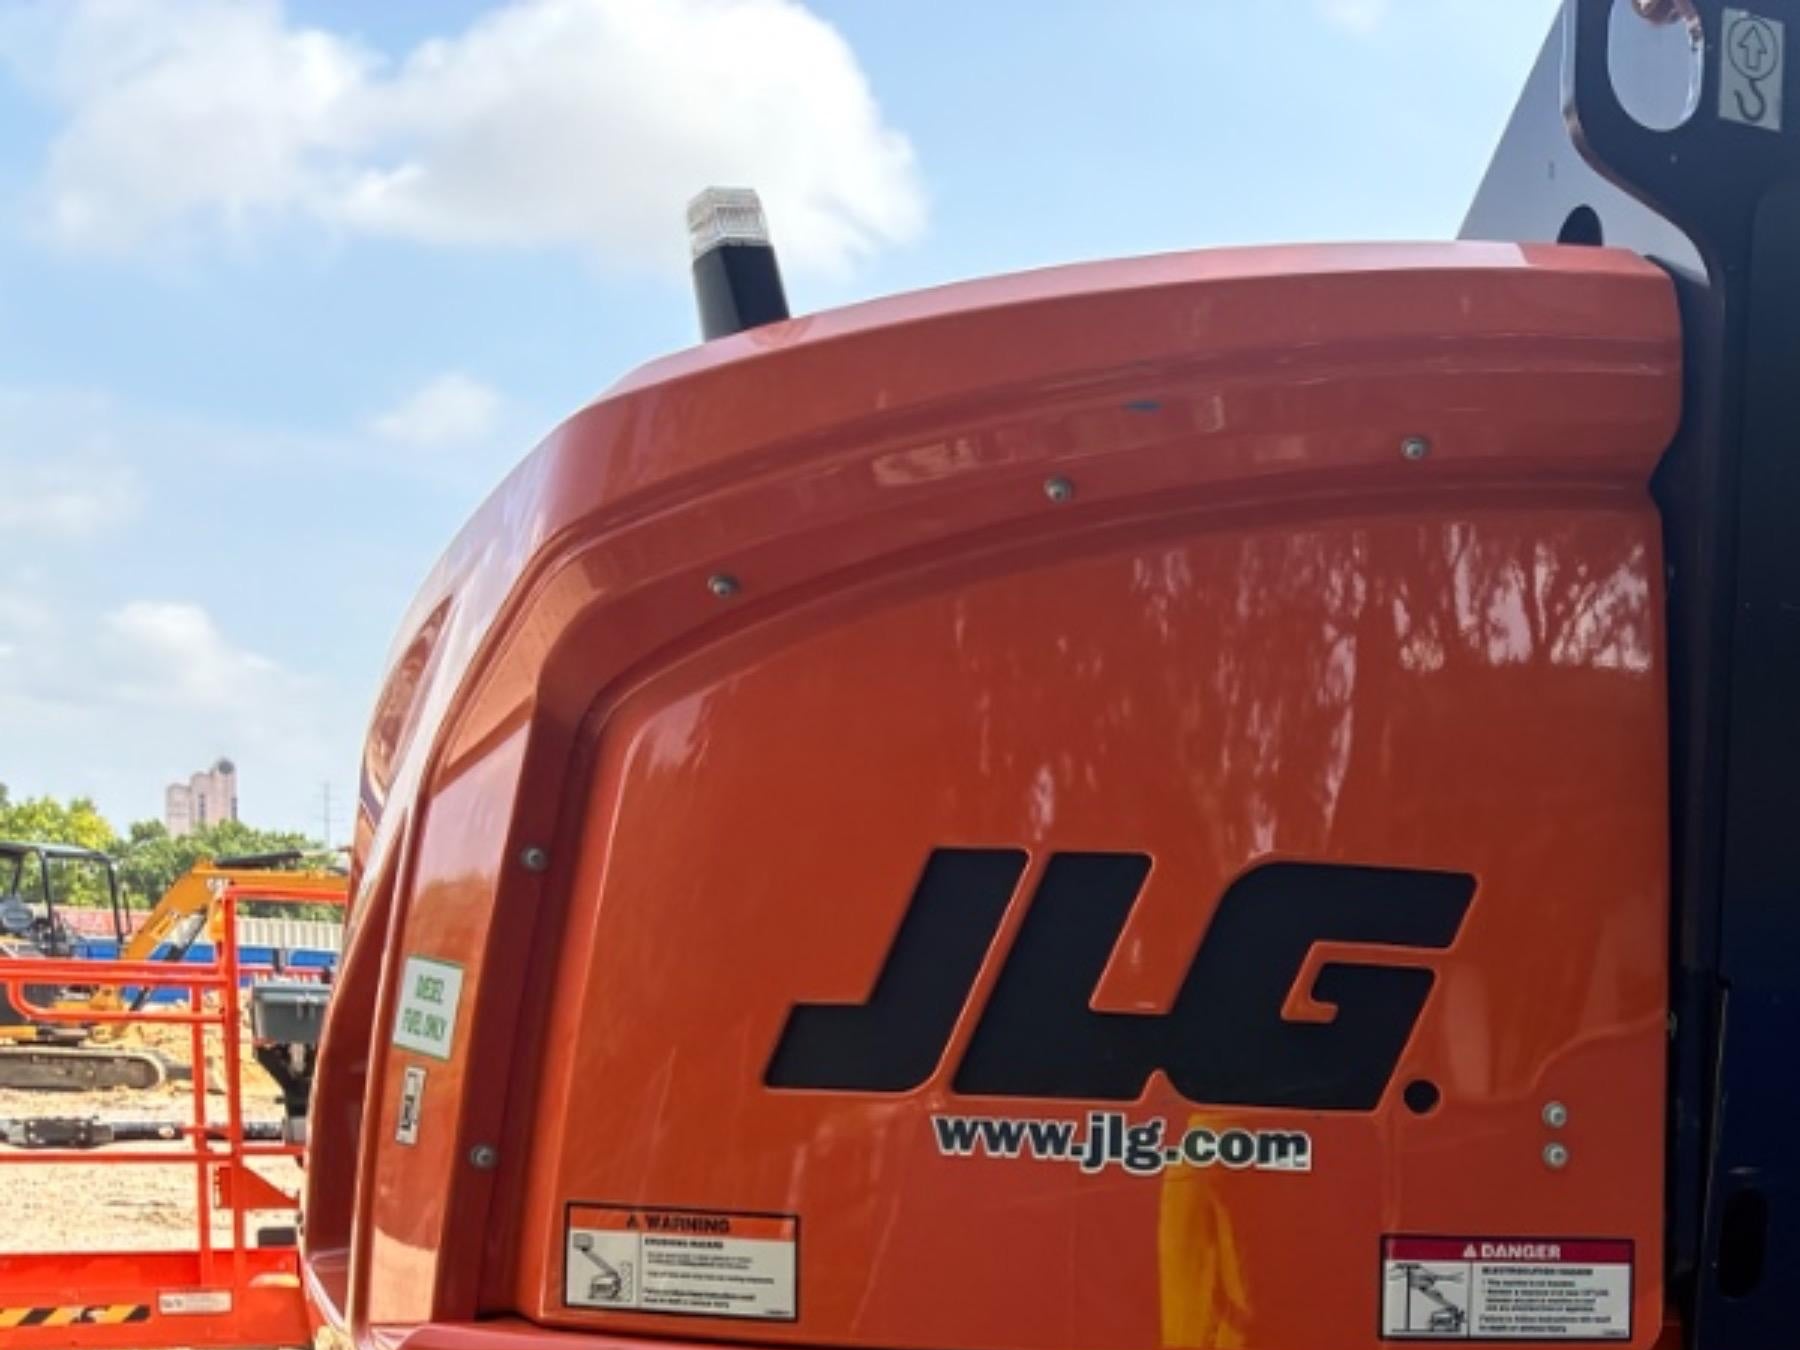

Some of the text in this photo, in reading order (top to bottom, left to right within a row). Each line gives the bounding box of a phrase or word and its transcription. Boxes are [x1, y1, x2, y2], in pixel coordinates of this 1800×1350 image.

[934, 1114, 1311, 1174] www.jlg.com
[644, 1214, 731, 1233] WARNING
[1481, 1244, 1561, 1260] DANGER
